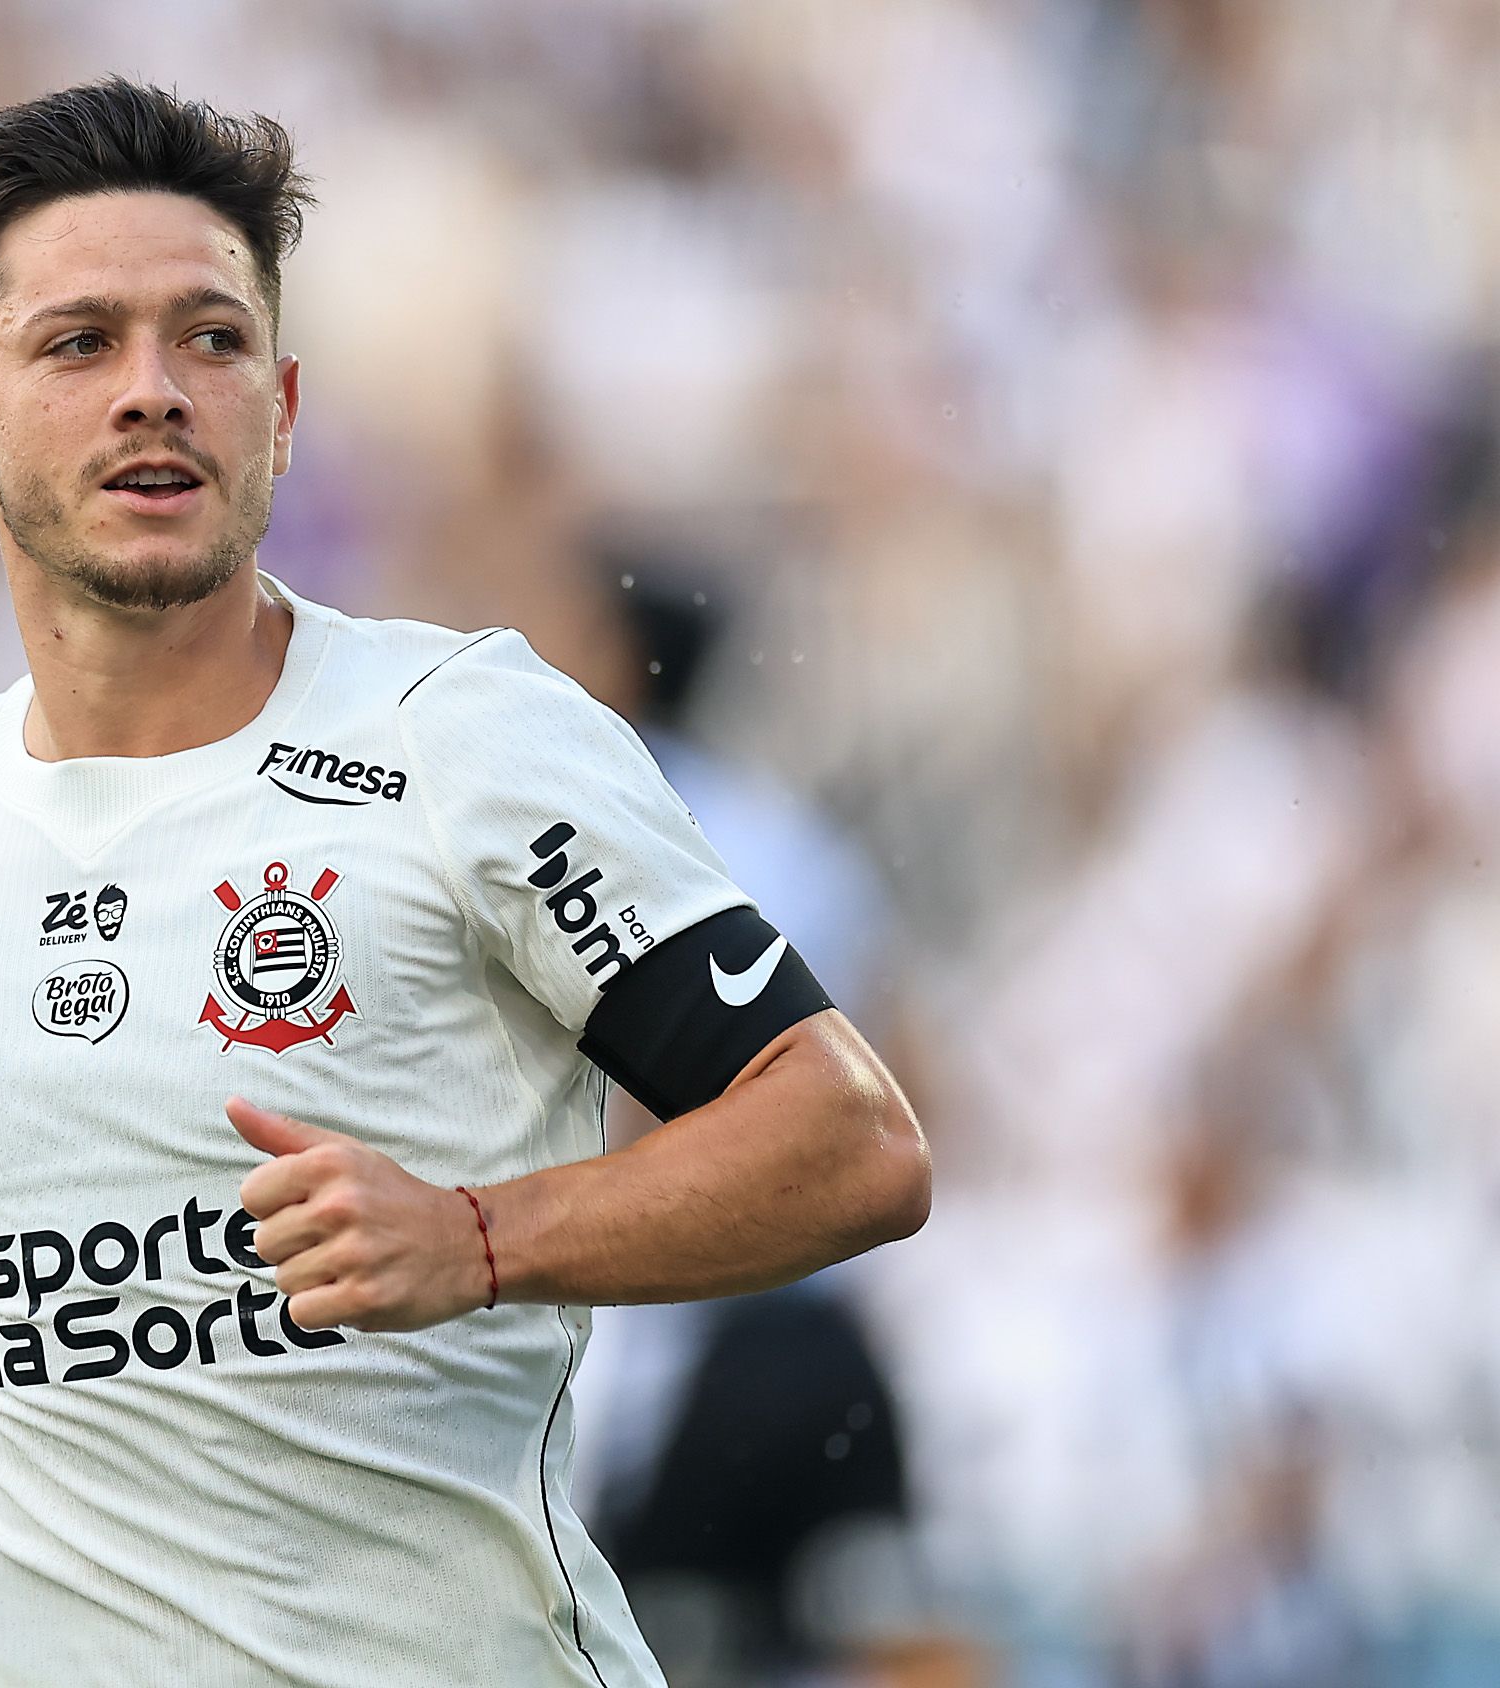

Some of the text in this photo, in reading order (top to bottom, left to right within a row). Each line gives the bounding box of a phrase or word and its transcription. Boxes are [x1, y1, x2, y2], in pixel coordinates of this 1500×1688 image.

[257, 743, 407, 802] Fimesa
[42, 890, 89, 934] Zé
[545, 867, 635, 993] bm
[618, 905, 655, 950] ban
[39, 933, 88, 946] DELIVERY
[227, 902, 326, 987] S.C. CORINTHIANS PAULISTA
[46, 972, 113, 1000] Broto
[51, 989, 116, 1026] Legal
[259, 993, 291, 1006] 1910
